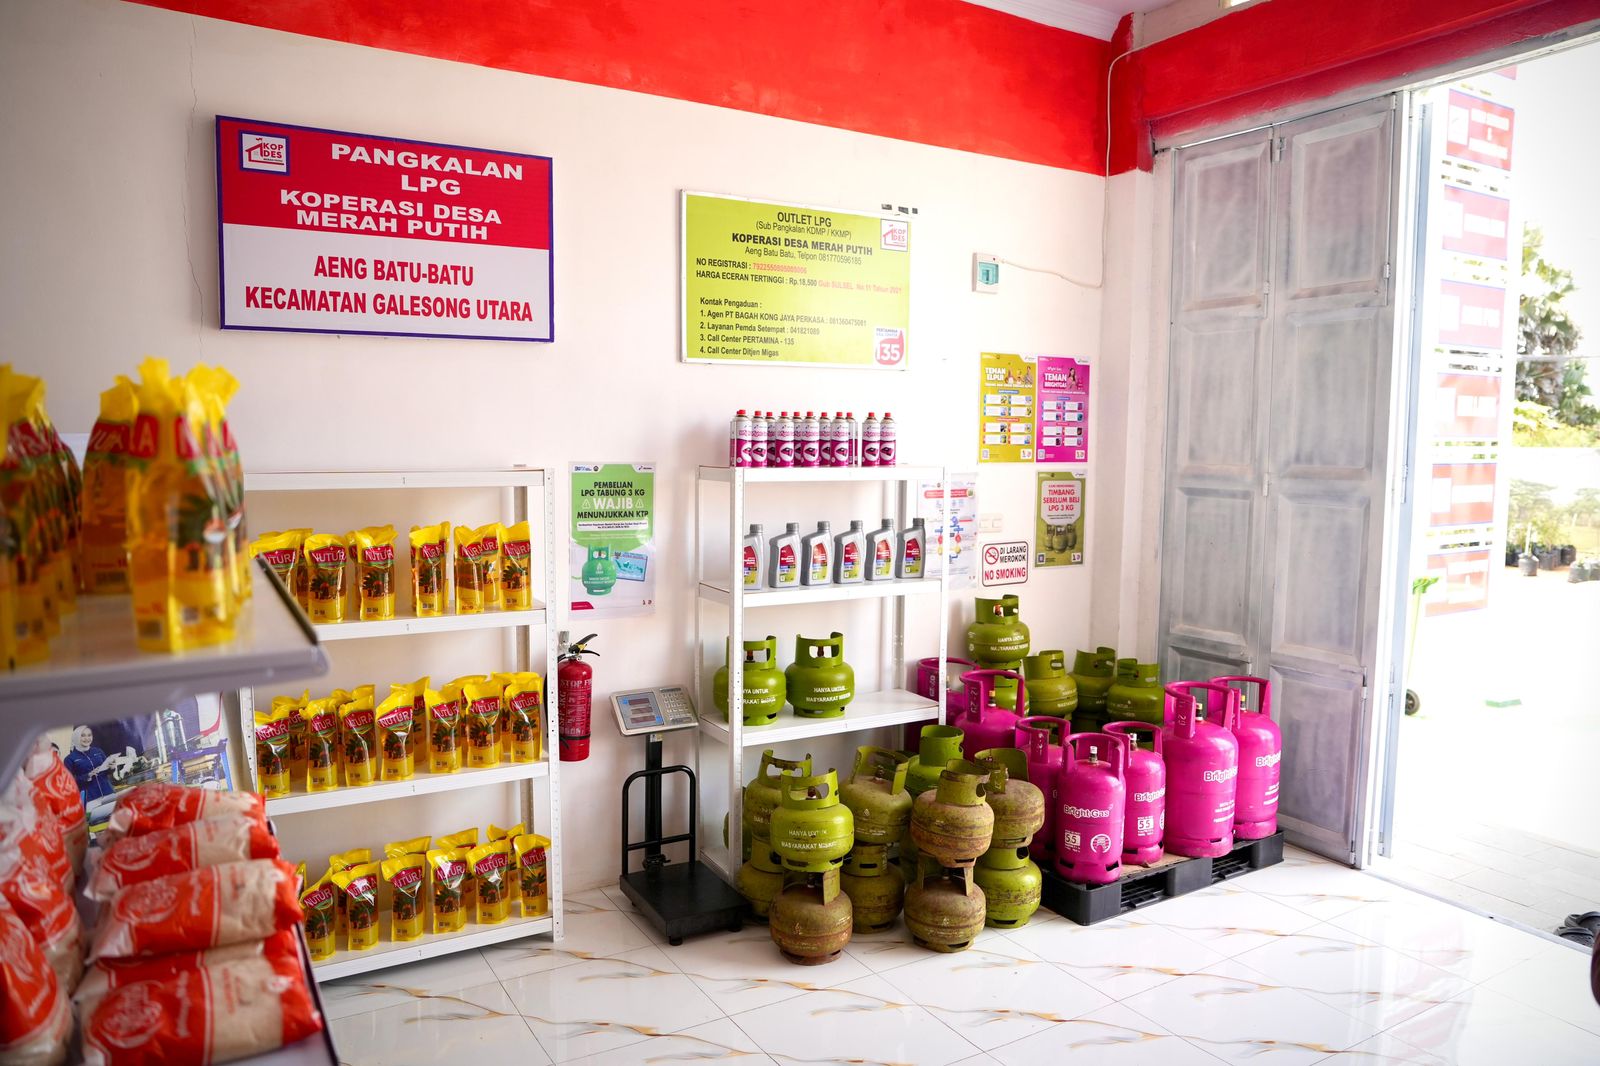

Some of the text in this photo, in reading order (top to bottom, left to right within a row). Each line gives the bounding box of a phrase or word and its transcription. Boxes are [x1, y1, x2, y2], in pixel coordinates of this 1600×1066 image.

[263, 142, 284, 151] KOP
[263, 150, 282, 159] DES
[331, 143, 523, 181] PANGKALAN
[401, 174, 461, 195] LPG
[280, 189, 502, 224] KOPERASI DESA
[296, 209, 488, 241] MERAH PUTIH
[777, 212, 832, 227] OUTLET LPG
[756, 220, 771, 231] (Sub
[773, 222, 805, 234] Pangkalan
[806, 226, 826, 236] KDMP
[732, 233, 873, 256] KOPERASI DESA MERAH PUTIH
[745, 246, 762, 257] Aeng
[763, 248, 778, 256] Batu
[696, 258, 707, 266] NO
[707, 259, 748, 269] REGISTRASI
[314, 255, 474, 286] AENG BATU-BATU
[696, 270, 721, 279] HARGA
[722, 272, 749, 281] ECERAN
[751, 274, 784, 284] TERTINGGI
[245, 285, 533, 322] KECAMATAN GALESONG UTARA
[700, 297, 723, 306] Kontak
[724, 298, 759, 309] Pengaduan
[707, 310, 724, 319] Agen
[735, 311, 759, 320] BAGAH
[760, 313, 778, 321] KONG
[779, 314, 795, 322] JAYA
[707, 322, 734, 331] Layanan
[735, 323, 756, 332] Pemda
[757, 324, 785, 334] Setempat
[707, 334, 719, 342] Call
[720, 335, 741, 343] Center
[742, 336, 779, 345] PERTAMINA
[707, 346, 719, 354] Call
[720, 347, 741, 355] Center
[761, 348, 779, 358] Migas
[1044, 373, 1067, 381] TEMAN
[593, 481, 633, 489] PEMBELIAN
[581, 488, 645, 497] LPG TABUNG 3 KG
[593, 498, 633, 510] WAJIB
[577, 510, 649, 519] MENUNJUKKAN KTP
[1000, 545, 1026, 555] DI LARANG
[1000, 554, 1026, 563] MEROKOK
[985, 567, 1026, 581] NO SMOKING
